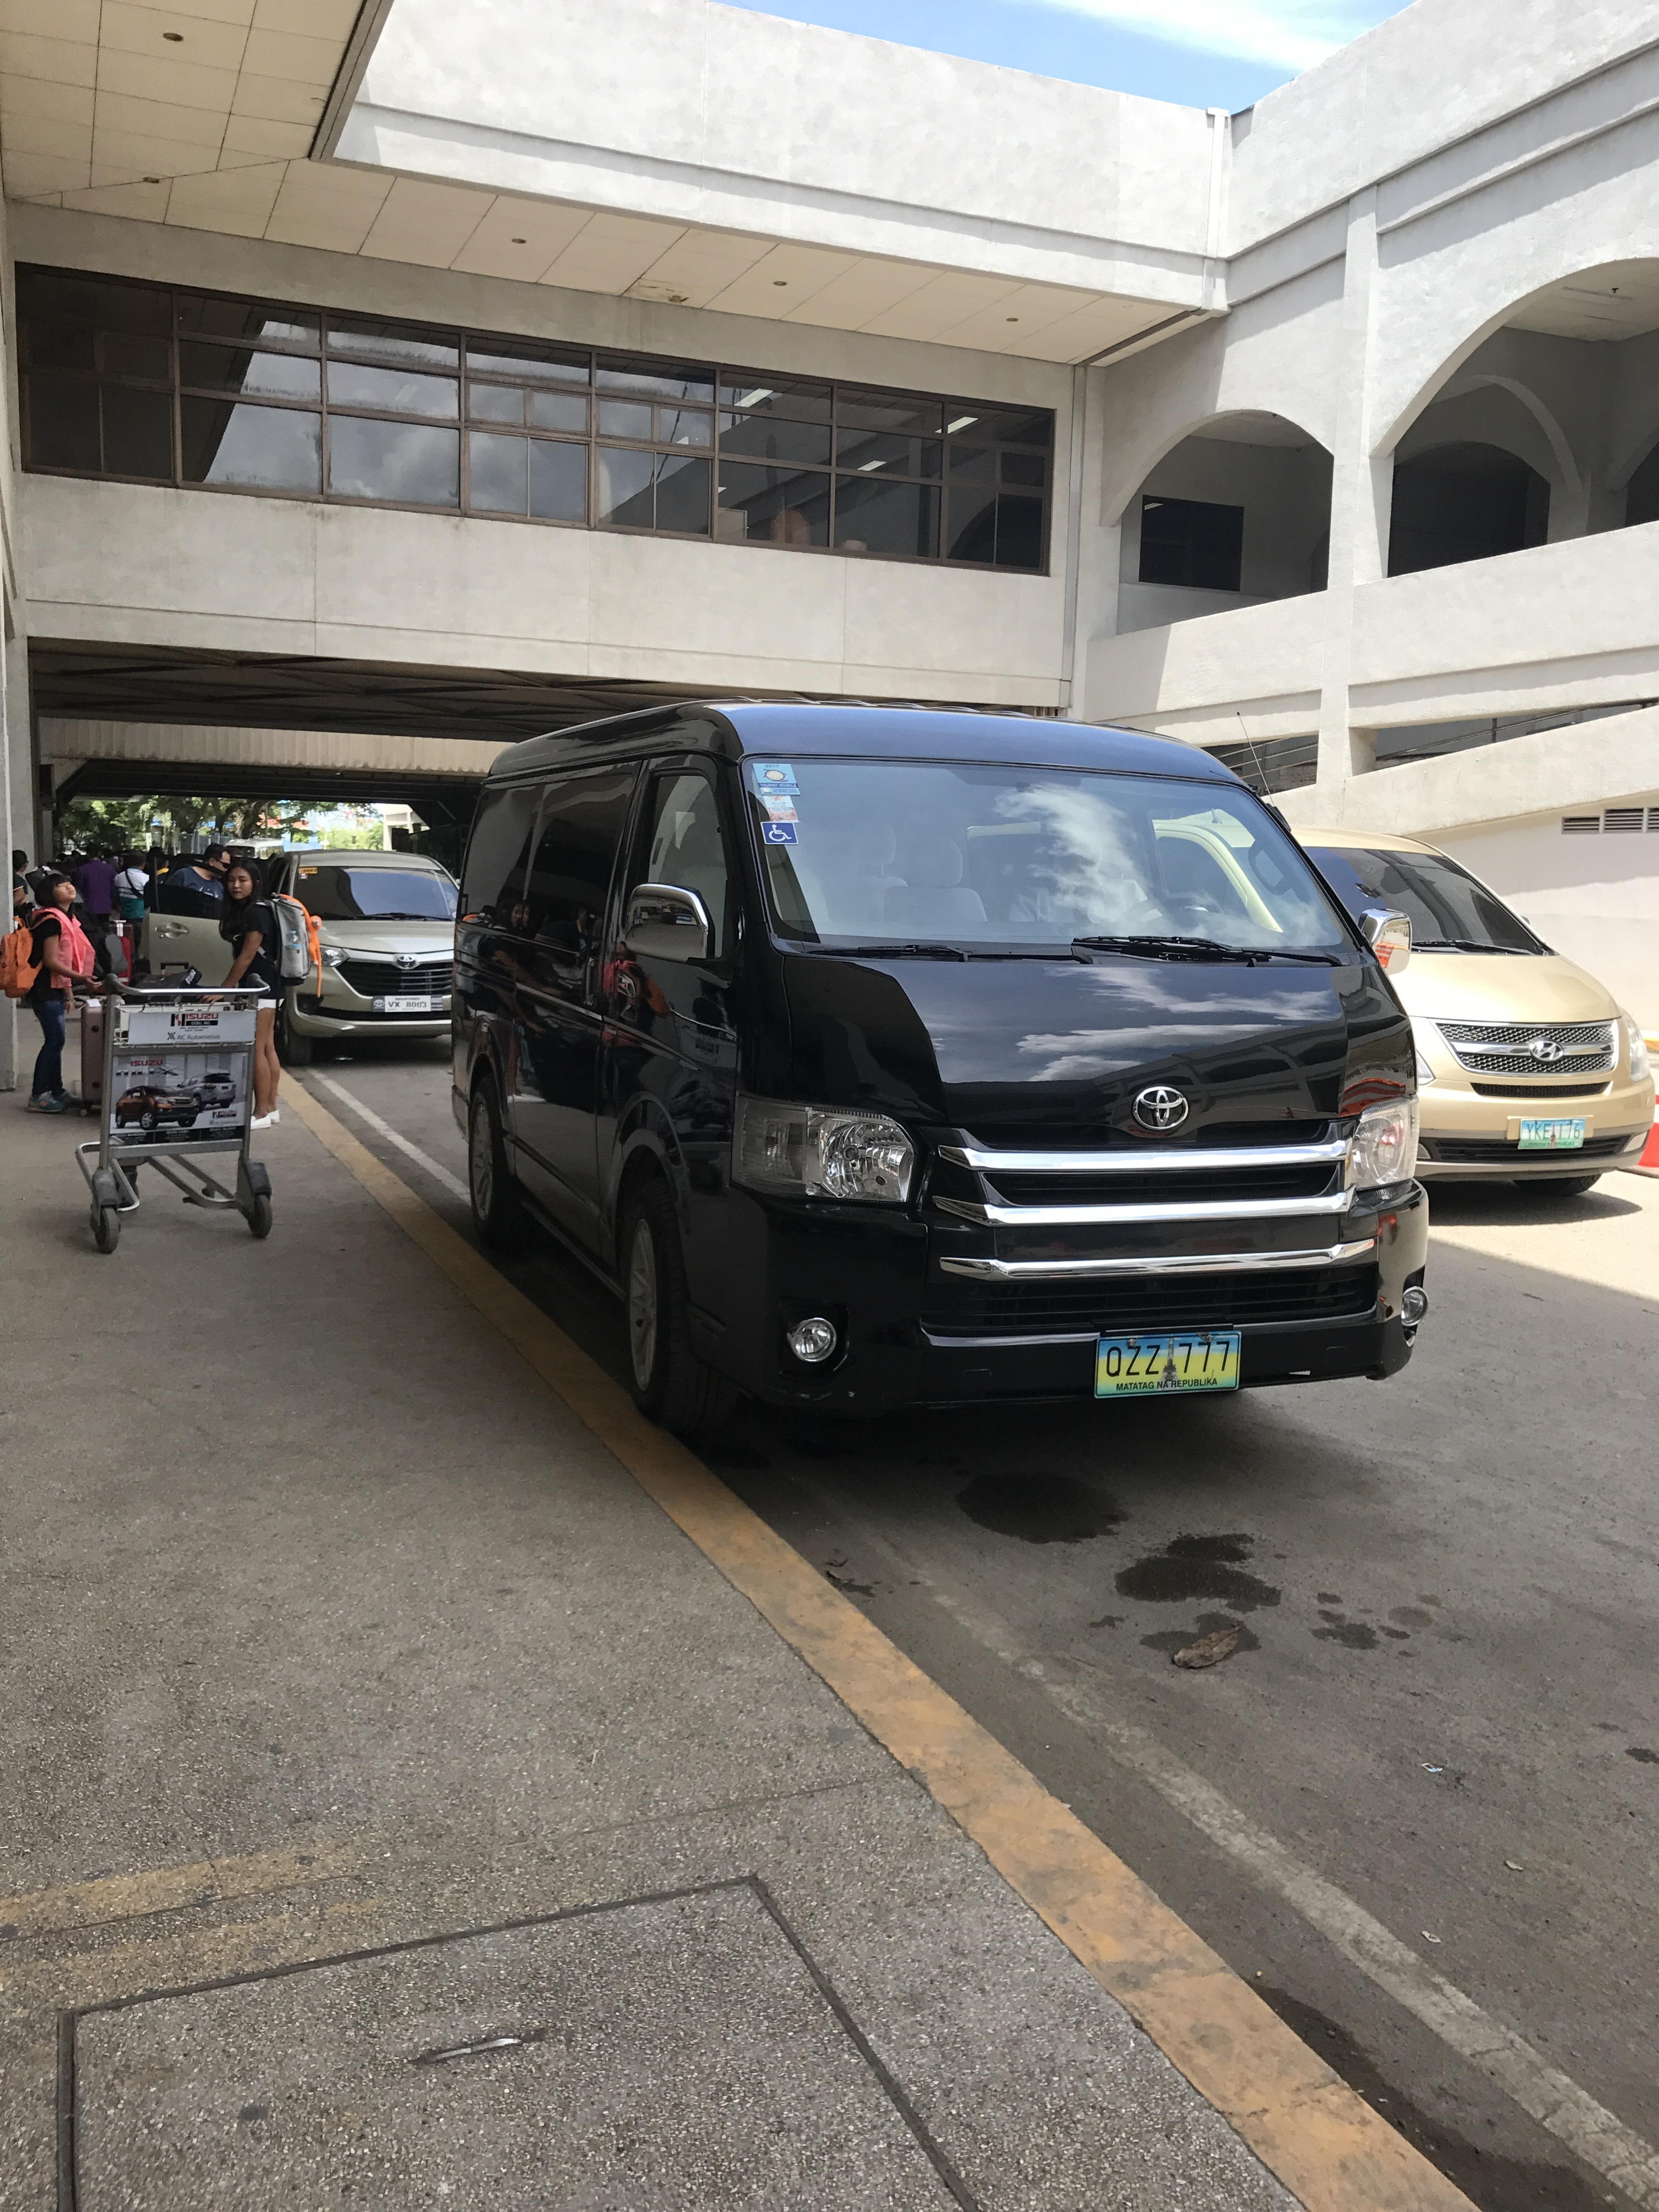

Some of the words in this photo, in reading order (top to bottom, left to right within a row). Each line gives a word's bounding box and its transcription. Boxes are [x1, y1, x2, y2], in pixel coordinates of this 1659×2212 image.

[1527, 1122, 1551, 1140] YKE
[1559, 1121, 1580, 1139] 176
[1178, 1341, 1230, 1374] 777
[1116, 1381, 1154, 1391] MATATAG
[1156, 1380, 1169, 1390] NA
[1170, 1378, 1217, 1388] REPUBLIKA
